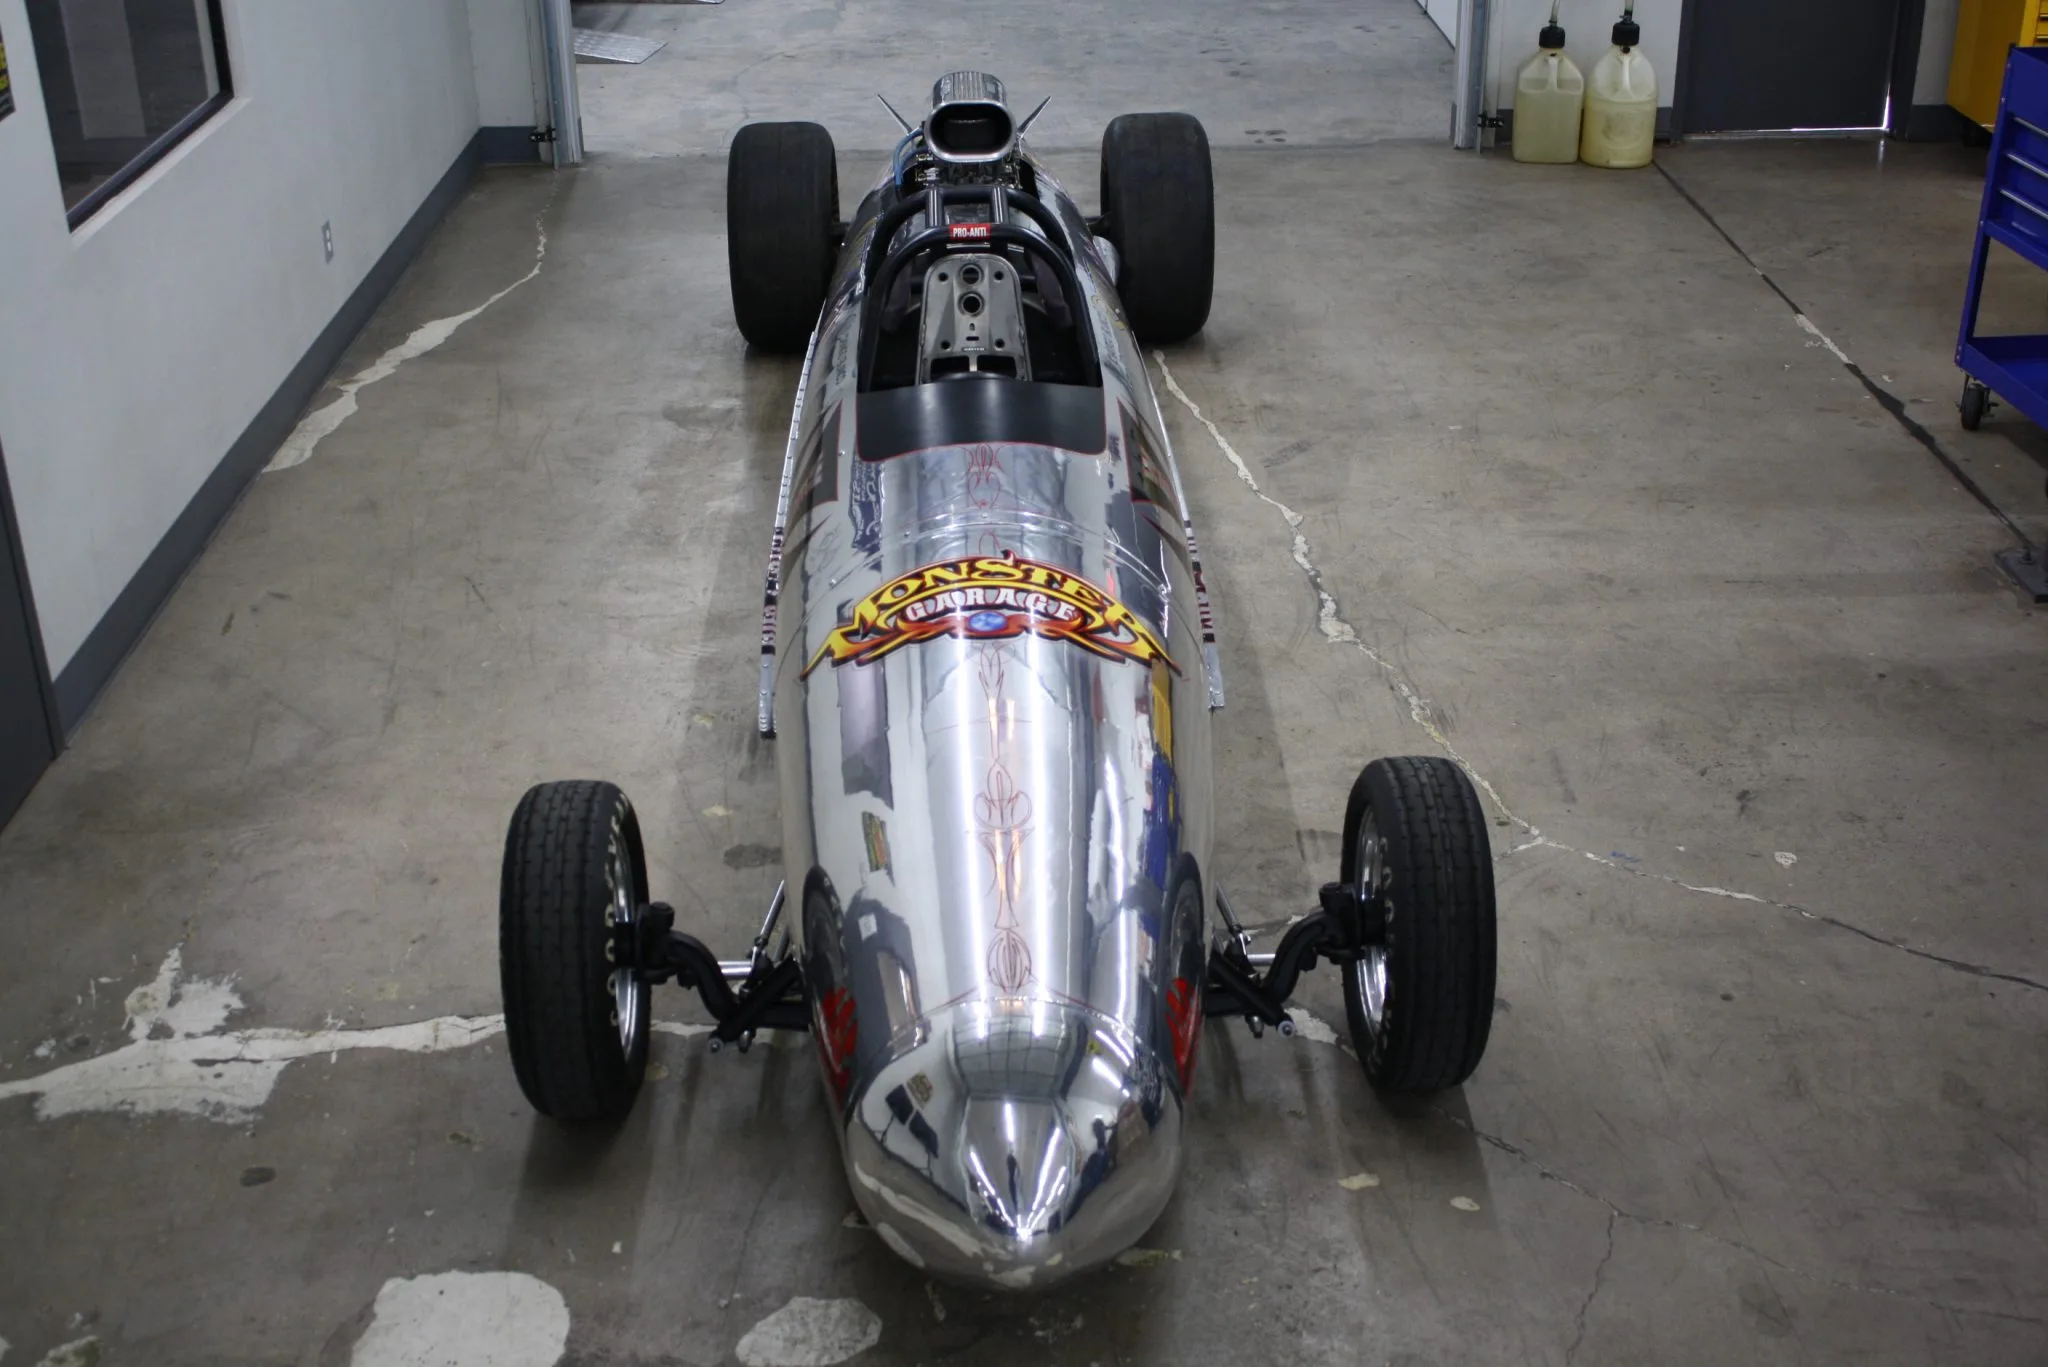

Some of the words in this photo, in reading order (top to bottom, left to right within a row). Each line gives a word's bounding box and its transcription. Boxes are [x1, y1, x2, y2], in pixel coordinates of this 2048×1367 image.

[952, 227, 987, 238] PRO-ANTI
[804, 552, 1178, 677] MONSTER
[905, 586, 1077, 621] GARAGE
